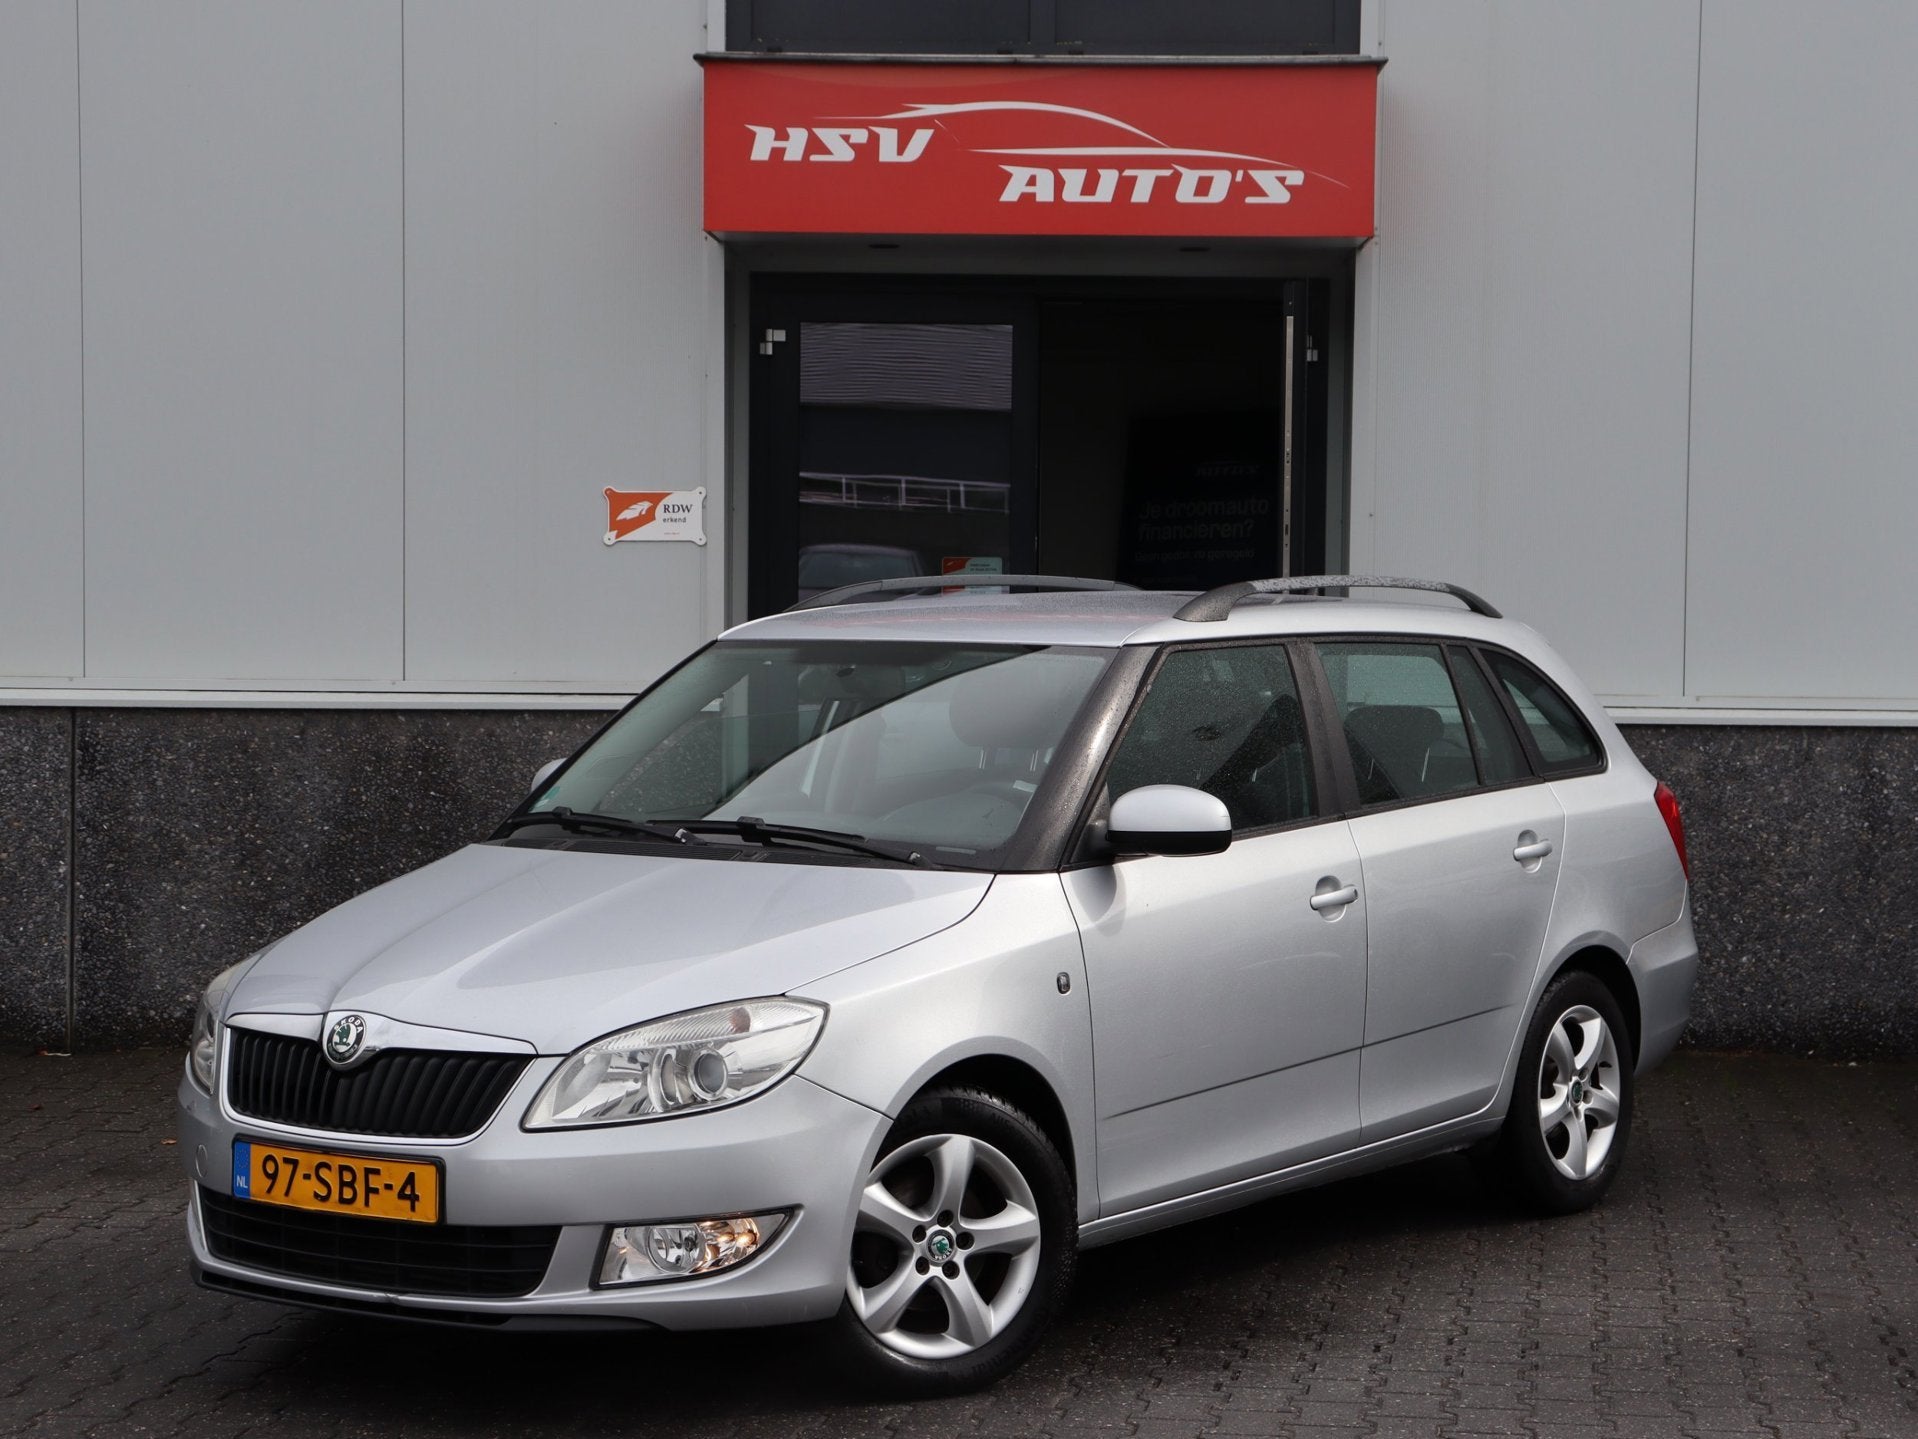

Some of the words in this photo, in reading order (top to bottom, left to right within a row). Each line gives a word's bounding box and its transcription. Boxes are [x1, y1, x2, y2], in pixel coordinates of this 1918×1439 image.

[744, 124, 933, 162] HSV
[1000, 164, 1304, 203] AUTO'S
[663, 504, 693, 513] RDW
[1166, 495, 1269, 518] droomauto
[1138, 518, 1255, 541] financieren?
[236, 1175, 248, 1189] NL
[262, 1154, 420, 1212] 97-SBF-4
